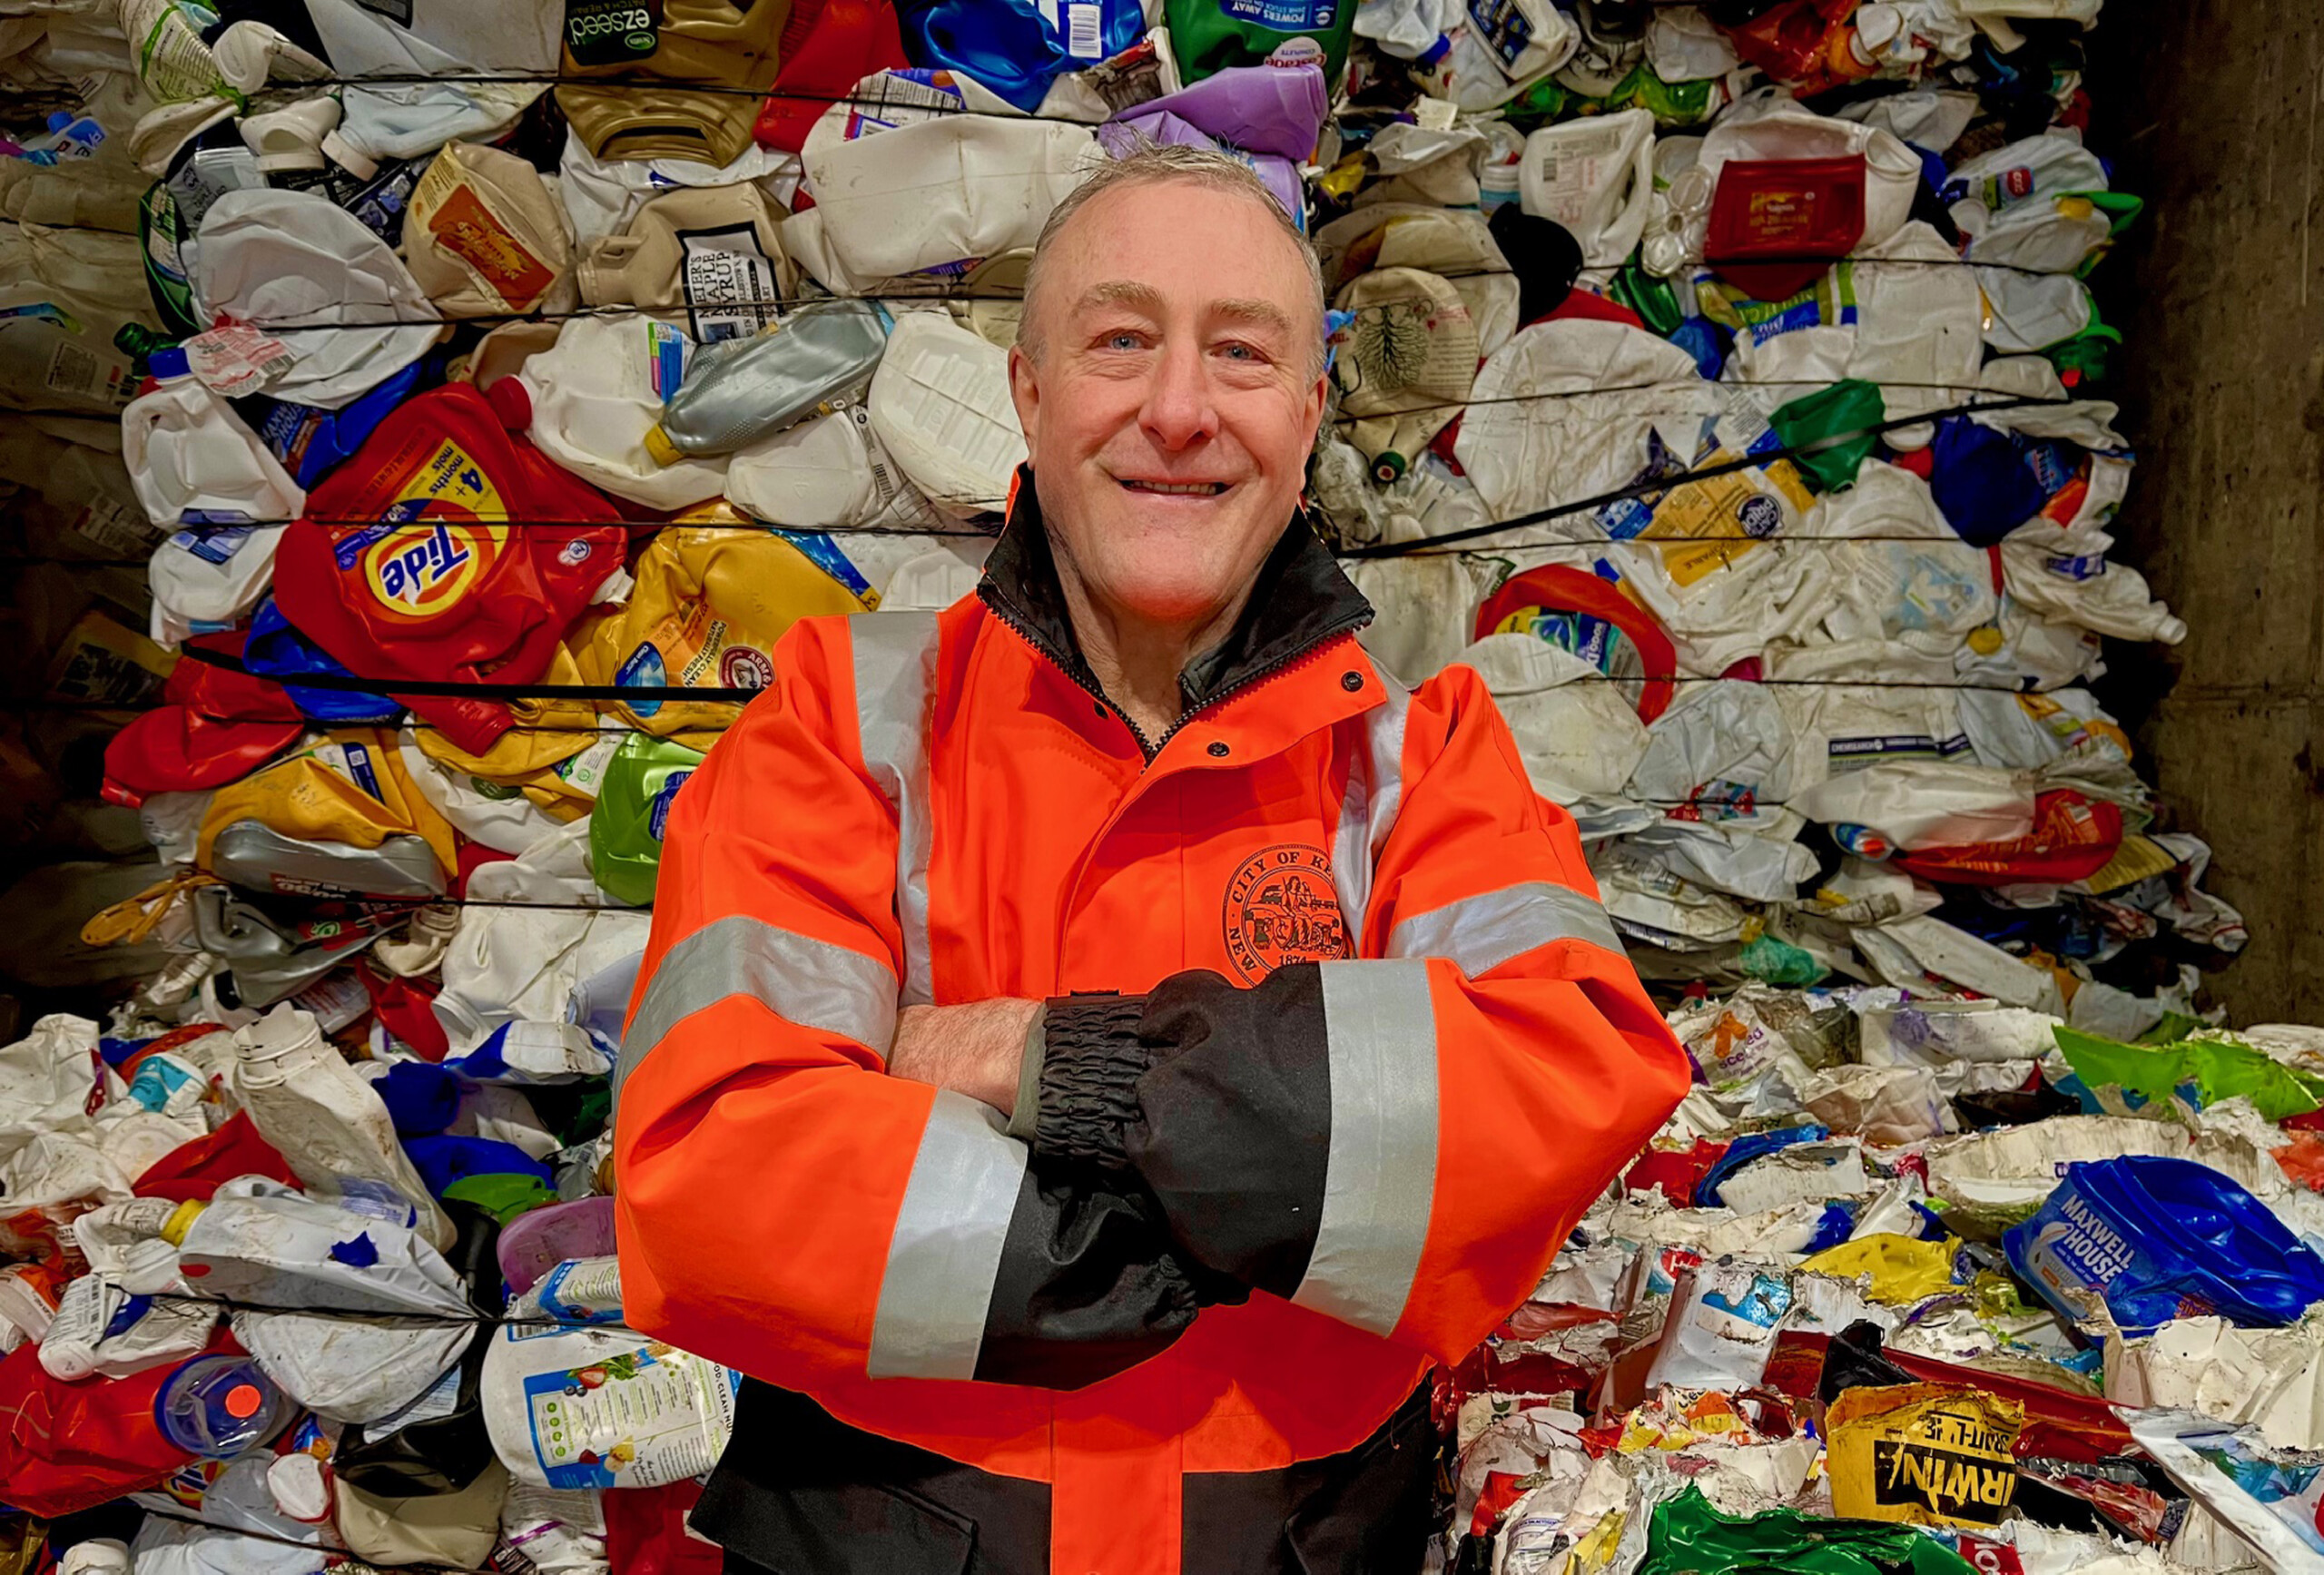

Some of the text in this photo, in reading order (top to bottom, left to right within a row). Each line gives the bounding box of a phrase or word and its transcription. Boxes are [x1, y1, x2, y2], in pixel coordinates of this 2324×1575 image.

[571, 8, 650, 45] ezseed
[1232, 3, 1305, 23] POWERS AWAY
[703, 253, 724, 317] MAPLE
[716, 251, 739, 316] SYRUP
[428, 455, 464, 497] months
[431, 446, 454, 471] mois
[381, 520, 470, 598] Tide
[682, 620, 720, 678] NATURALLY FRESH
[684, 621, 727, 687] POWERFULLY CLEAN
[1232, 858, 1267, 904] CITY
[1276, 851, 1300, 864] OF
[1228, 927, 1258, 971] NEW
[2061, 1193, 2136, 1270] MAXWELL
[2063, 1229, 2123, 1284] HOUSE
[717, 1382, 729, 1413] CLEAN
[1903, 1452, 2016, 1508] IRWIN
